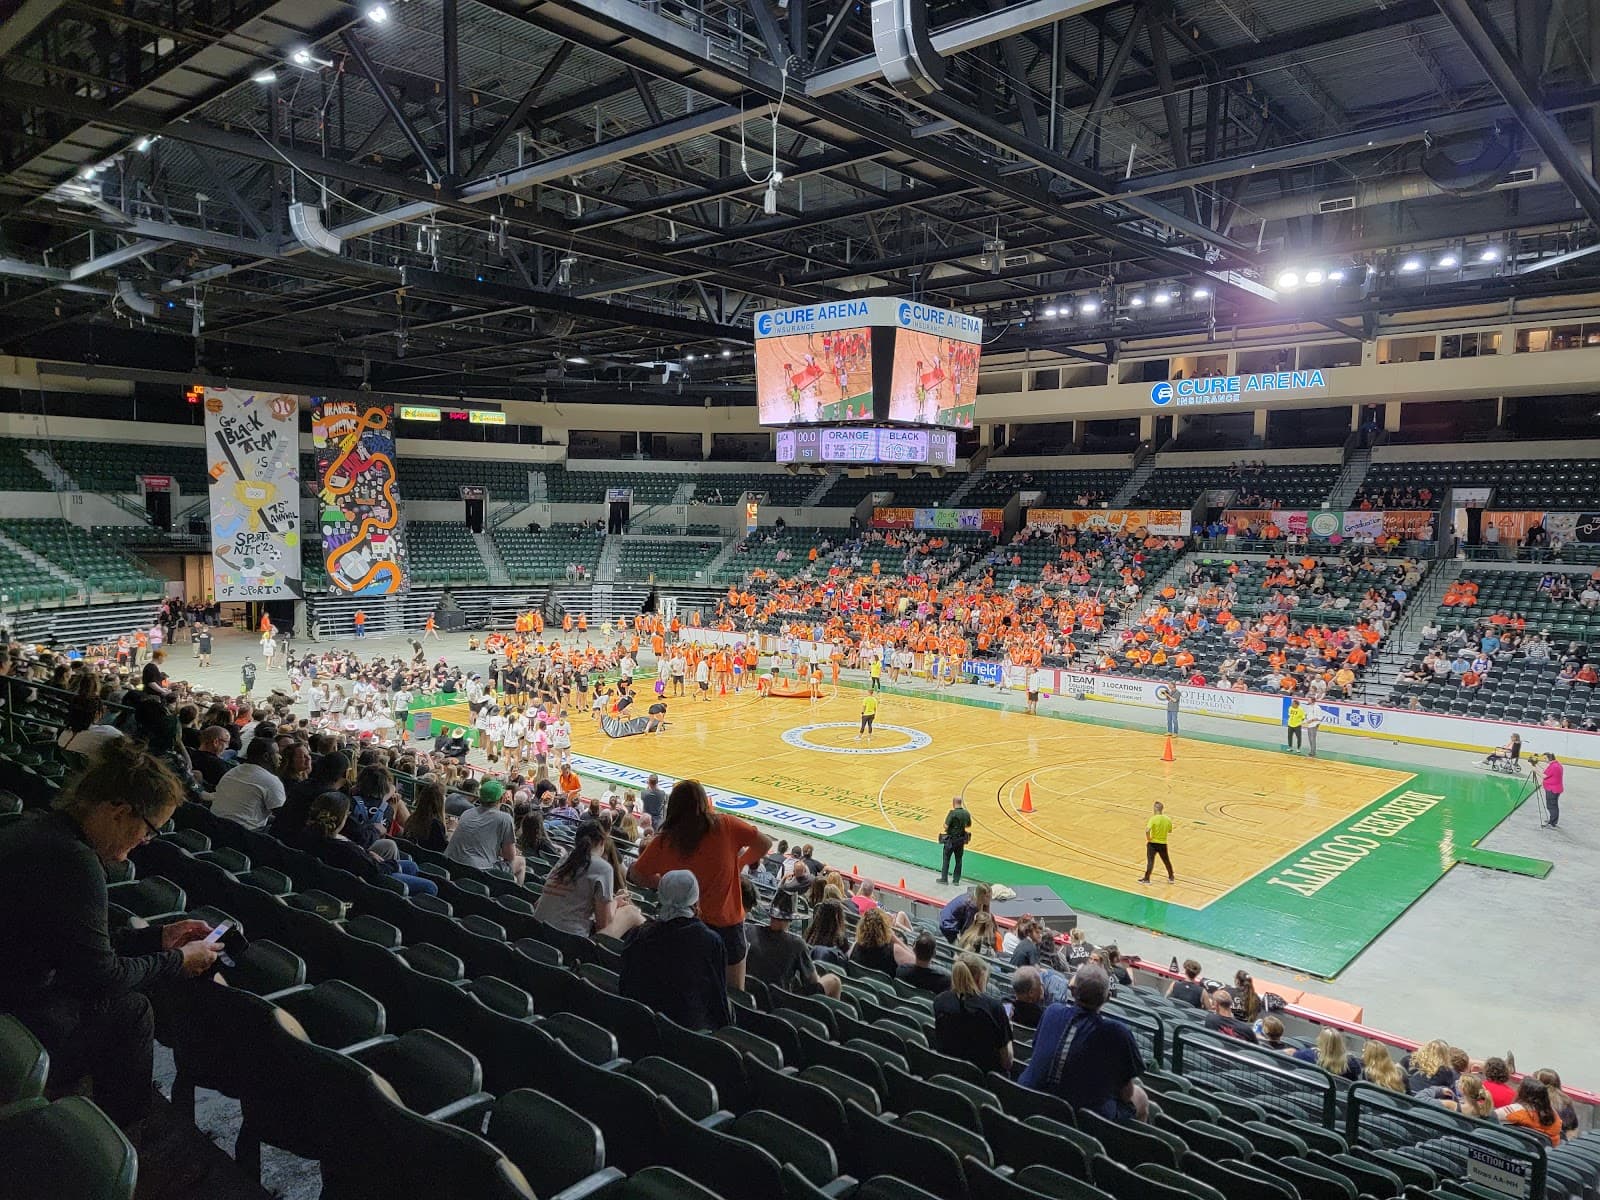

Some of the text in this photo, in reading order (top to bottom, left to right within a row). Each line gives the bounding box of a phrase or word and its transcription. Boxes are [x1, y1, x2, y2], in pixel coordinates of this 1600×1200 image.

[774, 301, 868, 326] CURE ARENA
[913, 305, 980, 333] CURE ARENA
[774, 323, 815, 334] INSURANCE
[1176, 369, 1326, 396] CURE ARENA
[1176, 394, 1241, 406] INSURANCE
[223, 410, 264, 445] BLACK
[237, 429, 277, 455] TEAM
[828, 431, 869, 440] ORANGE
[889, 432, 919, 441] BLACK
[849, 443, 869, 459] 17
[235, 531, 271, 546] SPORTS
[234, 544, 261, 556] NITE
[240, 585, 282, 596] SPORTS
[1066, 674, 1095, 685] TEAM
[1106, 682, 1143, 692] LOCATIONS
[1180, 690, 1235, 704] OTHMAN
[1180, 698, 1232, 710] RTHOPAEDICS
[830, 795, 931, 822] MERCER
[1347, 790, 1446, 837] MERCER
[754, 806, 837, 830] CURE
[1266, 834, 1381, 897] COUNTY
[1473, 1150, 1521, 1173] SECTION 114
